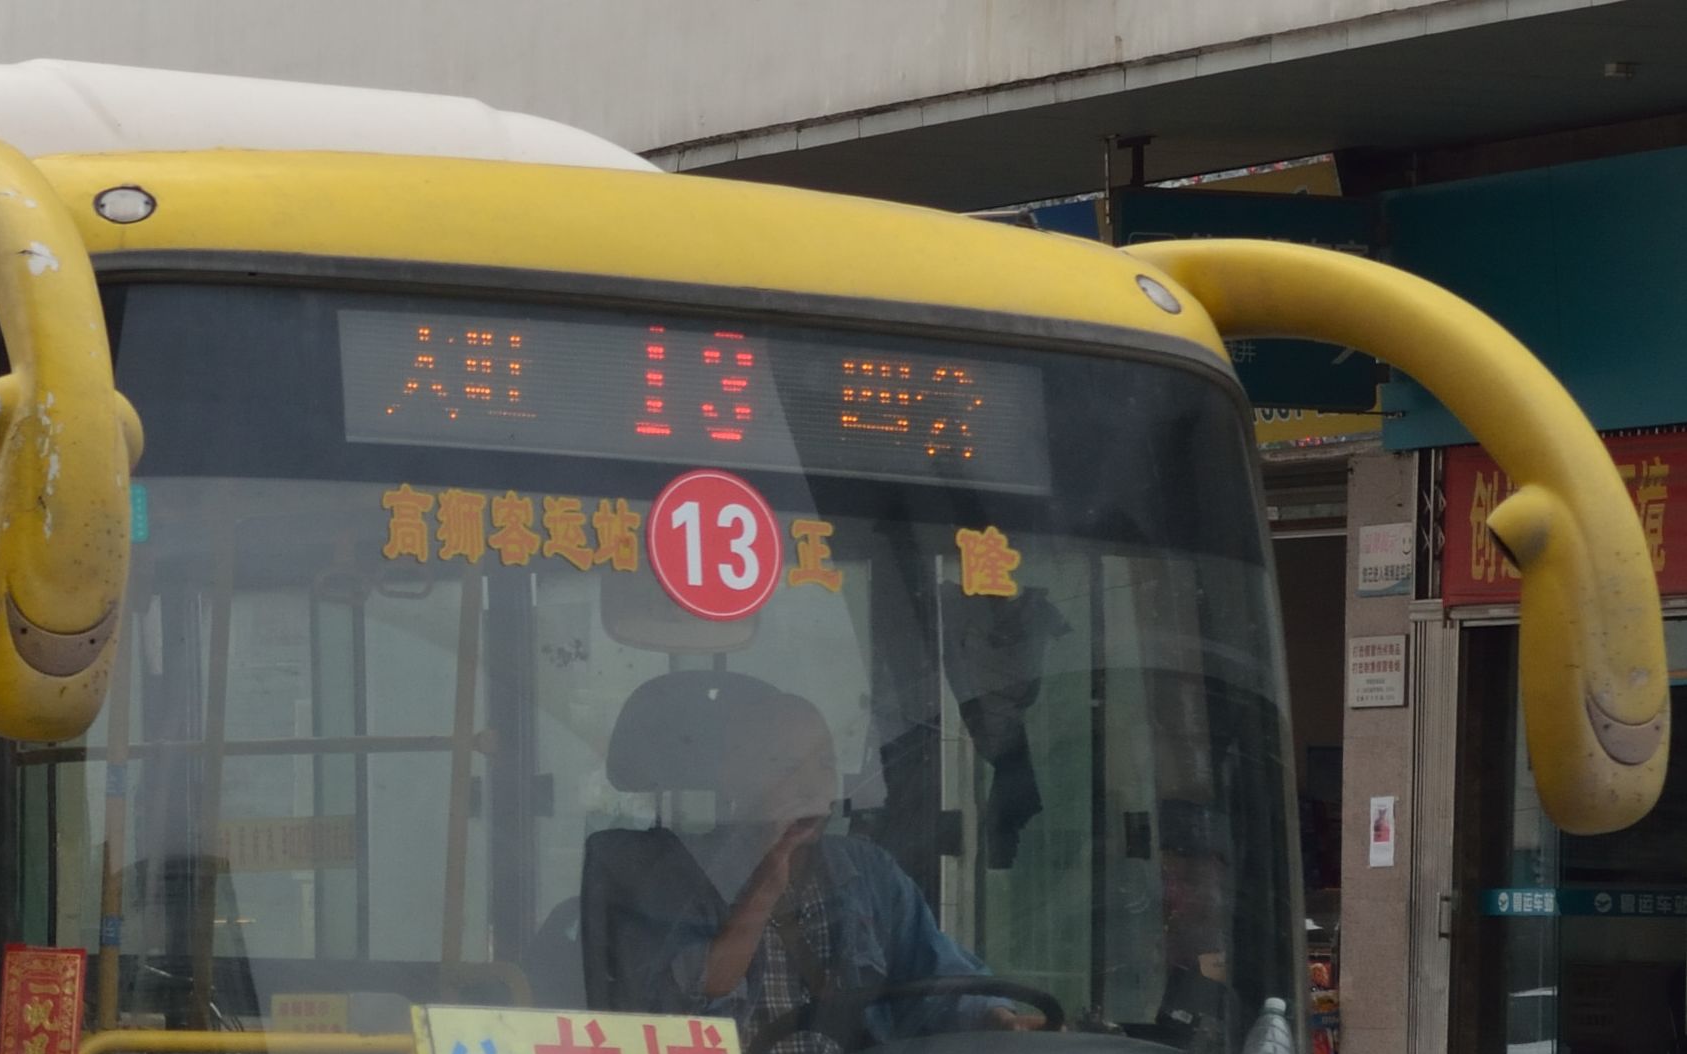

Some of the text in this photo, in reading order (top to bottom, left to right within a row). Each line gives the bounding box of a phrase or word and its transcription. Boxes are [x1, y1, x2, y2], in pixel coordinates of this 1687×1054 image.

[635, 325, 754, 442] 13
[382, 483, 641, 571] 高狮客运站
[671, 501, 760, 592] 13
